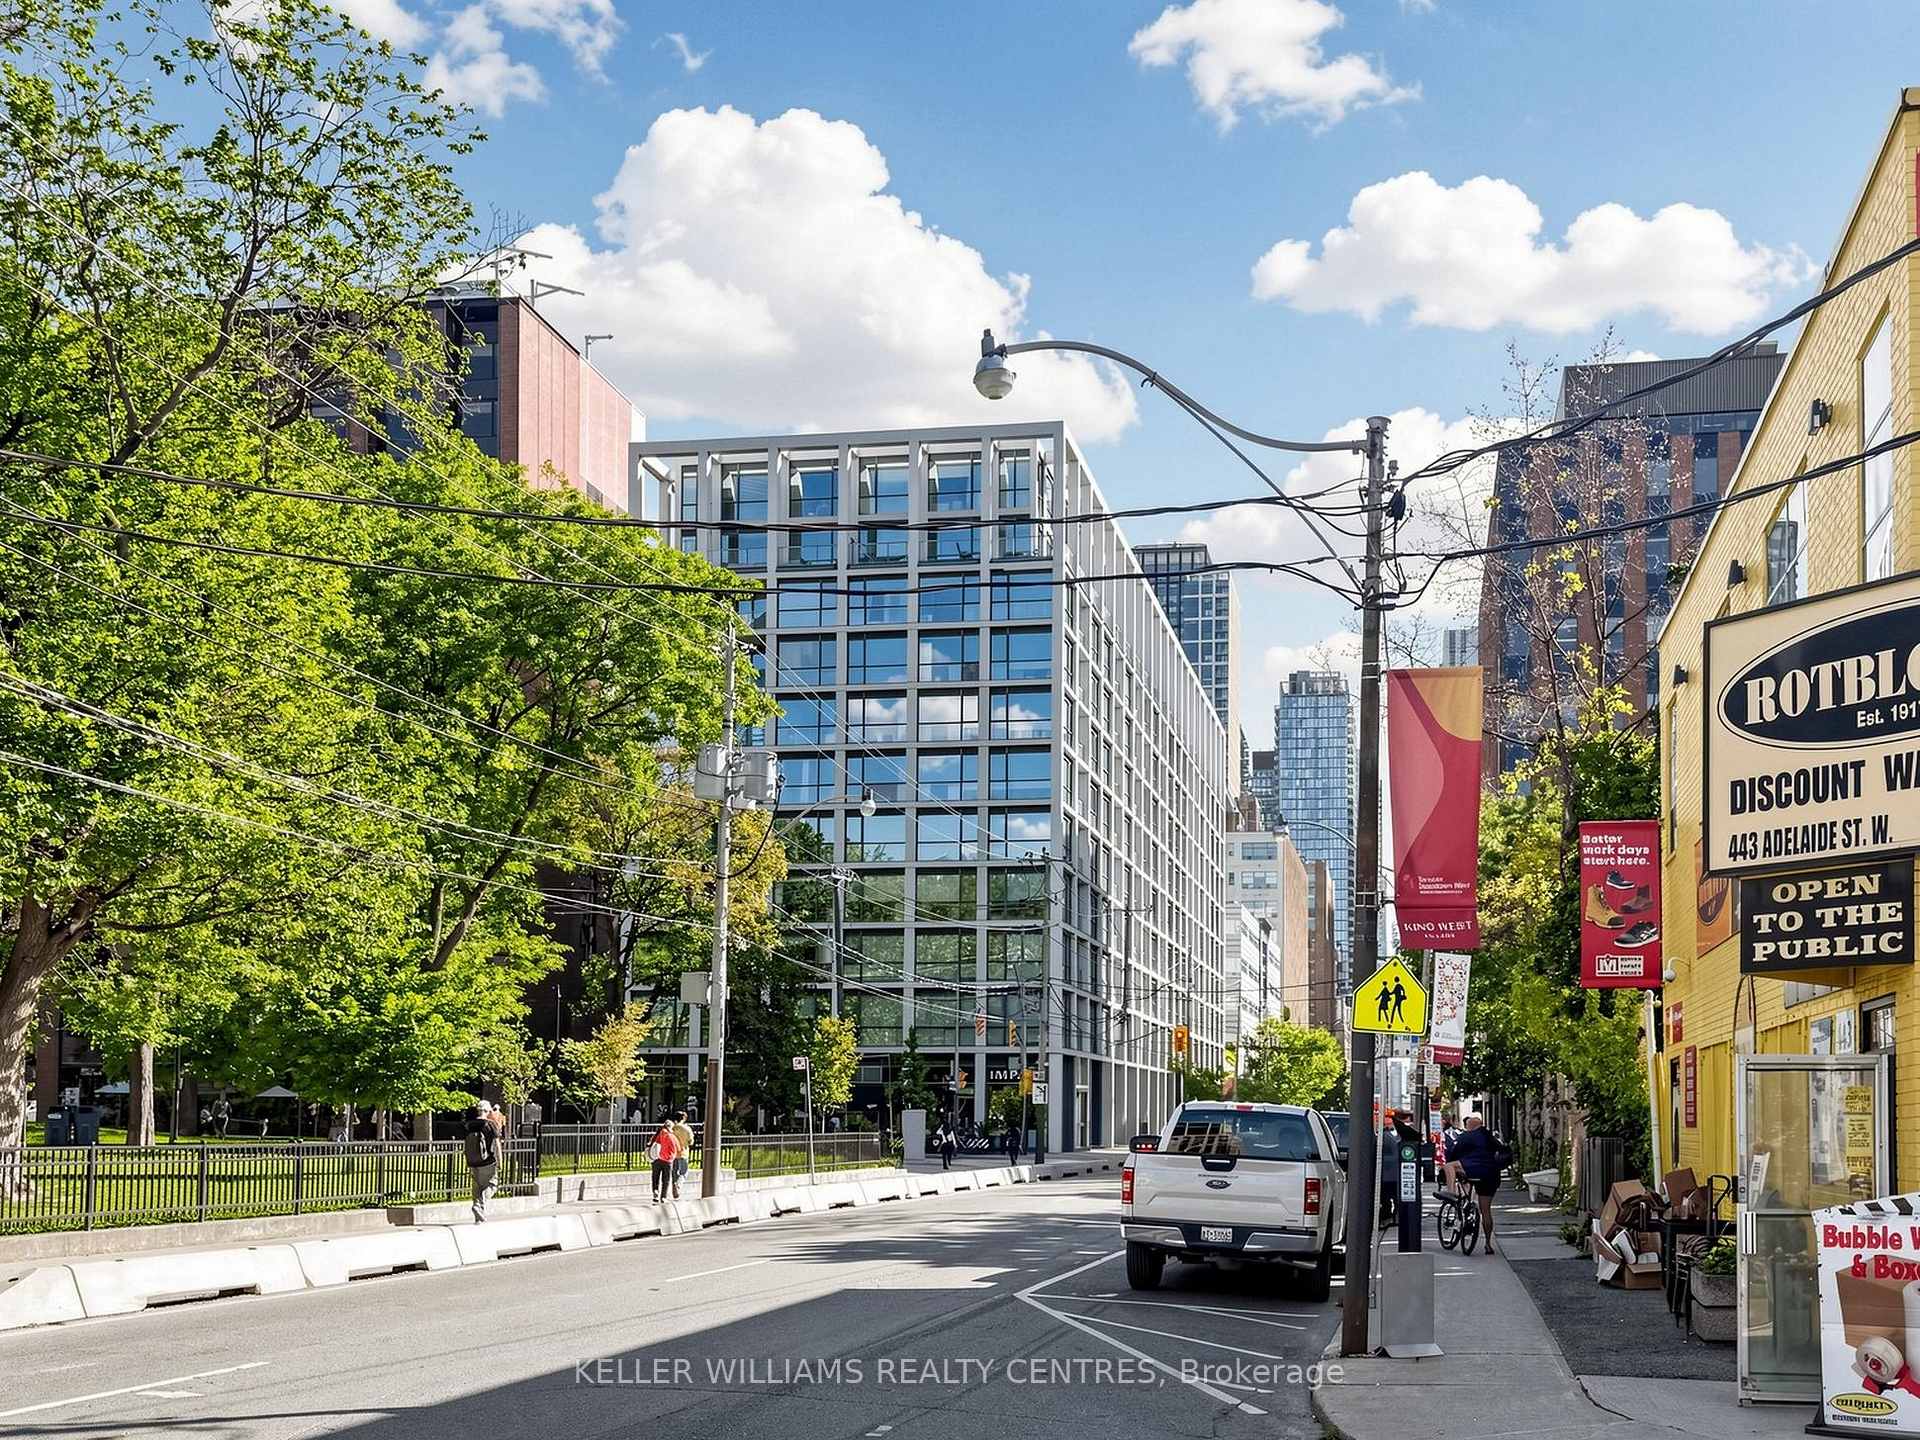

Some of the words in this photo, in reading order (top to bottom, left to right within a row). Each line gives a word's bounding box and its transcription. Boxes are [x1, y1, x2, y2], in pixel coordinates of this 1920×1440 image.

[1857, 709, 1884, 728] Est.
[1890, 700, 1920, 722] 191
[1730, 760, 1866, 815] DISCOUNT
[1583, 845, 1615, 855] work
[1729, 833, 1758, 862] 443
[1762, 821, 1838, 858] ADELAIDE
[1841, 818, 1867, 849] ST.
[1872, 815, 1893, 844] W.
[1771, 874, 1882, 903] OPEN
[1753, 911, 1804, 933] TO
[1815, 902, 1903, 928] THE
[1752, 931, 1904, 962] PUBLIC
[1823, 1224, 1903, 1251] Bubble
[1852, 1254, 1868, 1279] &
[1874, 1254, 1920, 1281] Box
